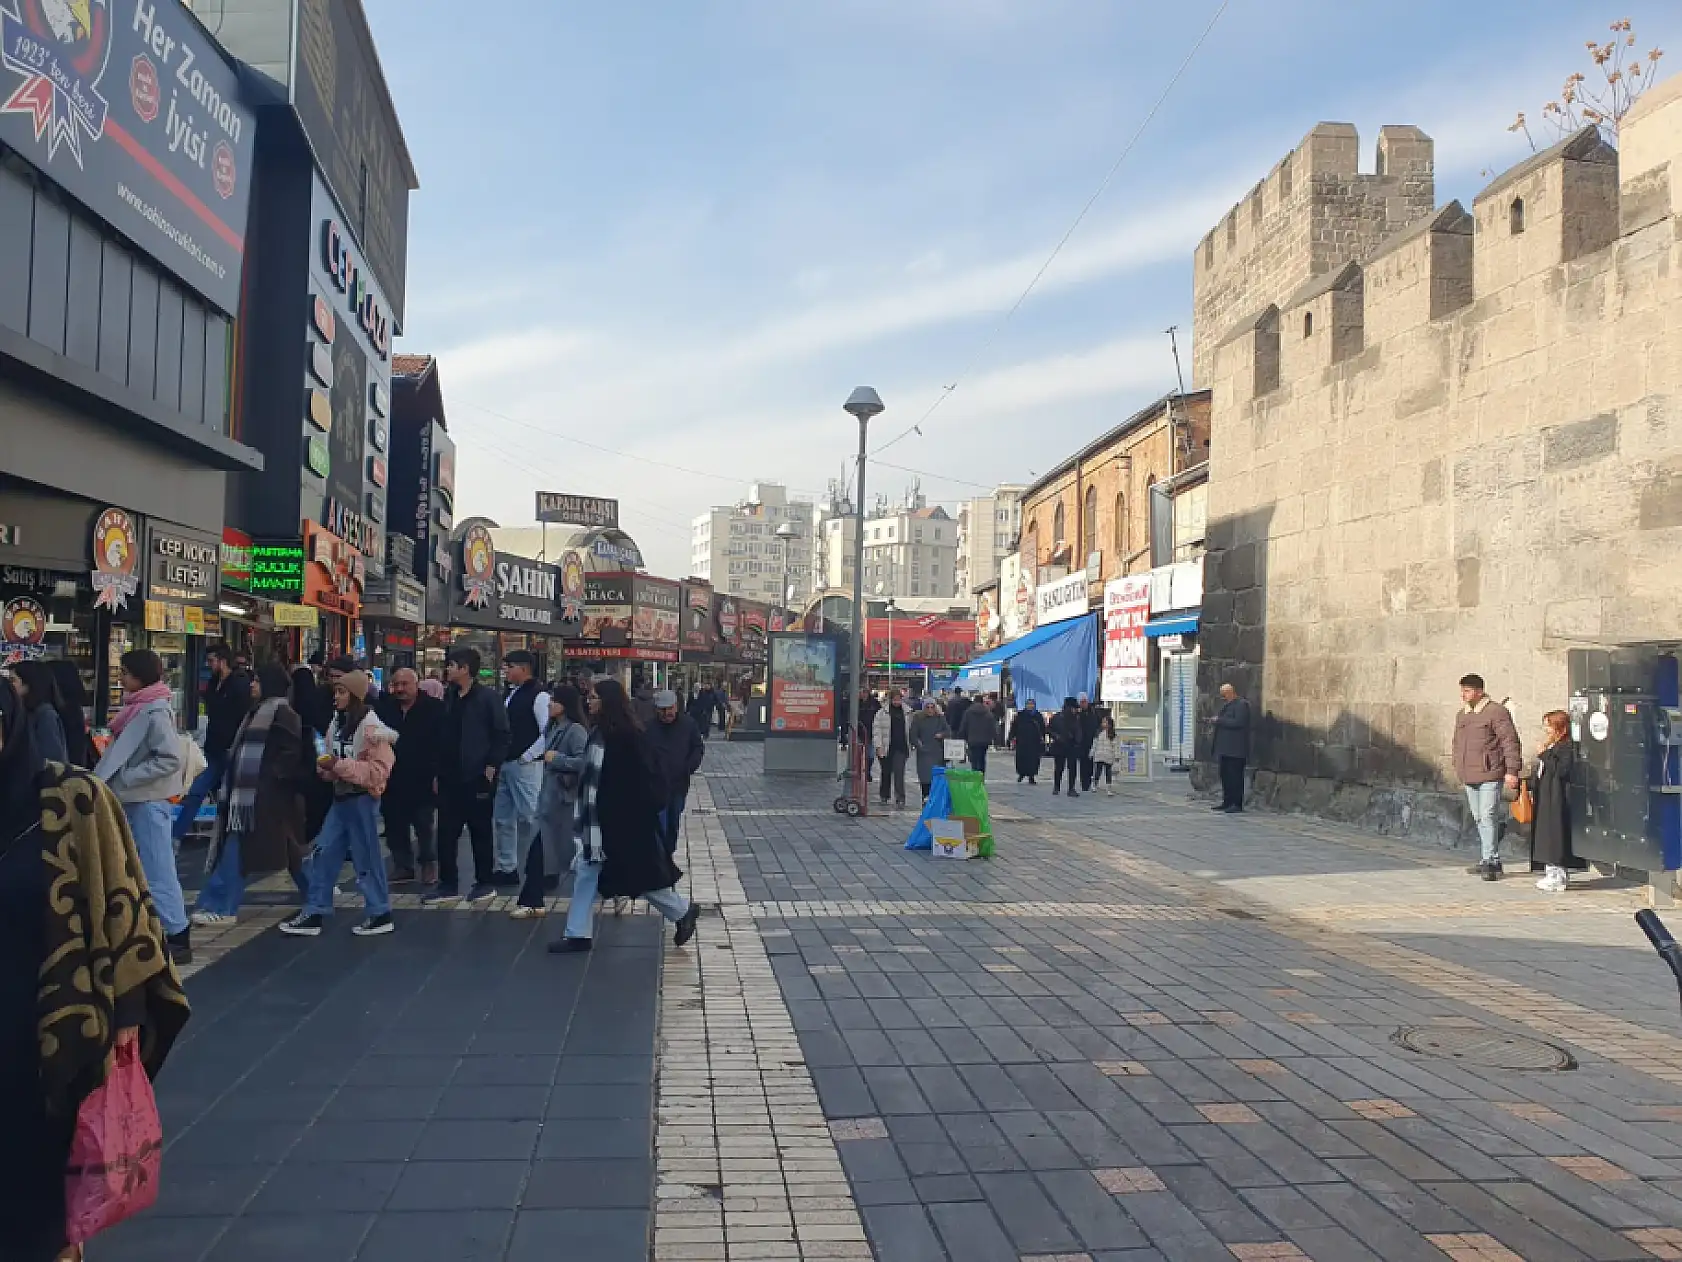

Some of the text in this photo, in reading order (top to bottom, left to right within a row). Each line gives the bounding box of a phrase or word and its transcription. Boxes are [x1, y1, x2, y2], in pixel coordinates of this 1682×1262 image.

[133, 0, 175, 64] Her
[176, 42, 241, 144] Zaman
[160, 538, 181, 557] CEP
[254, 562, 301, 574] SUCUK
